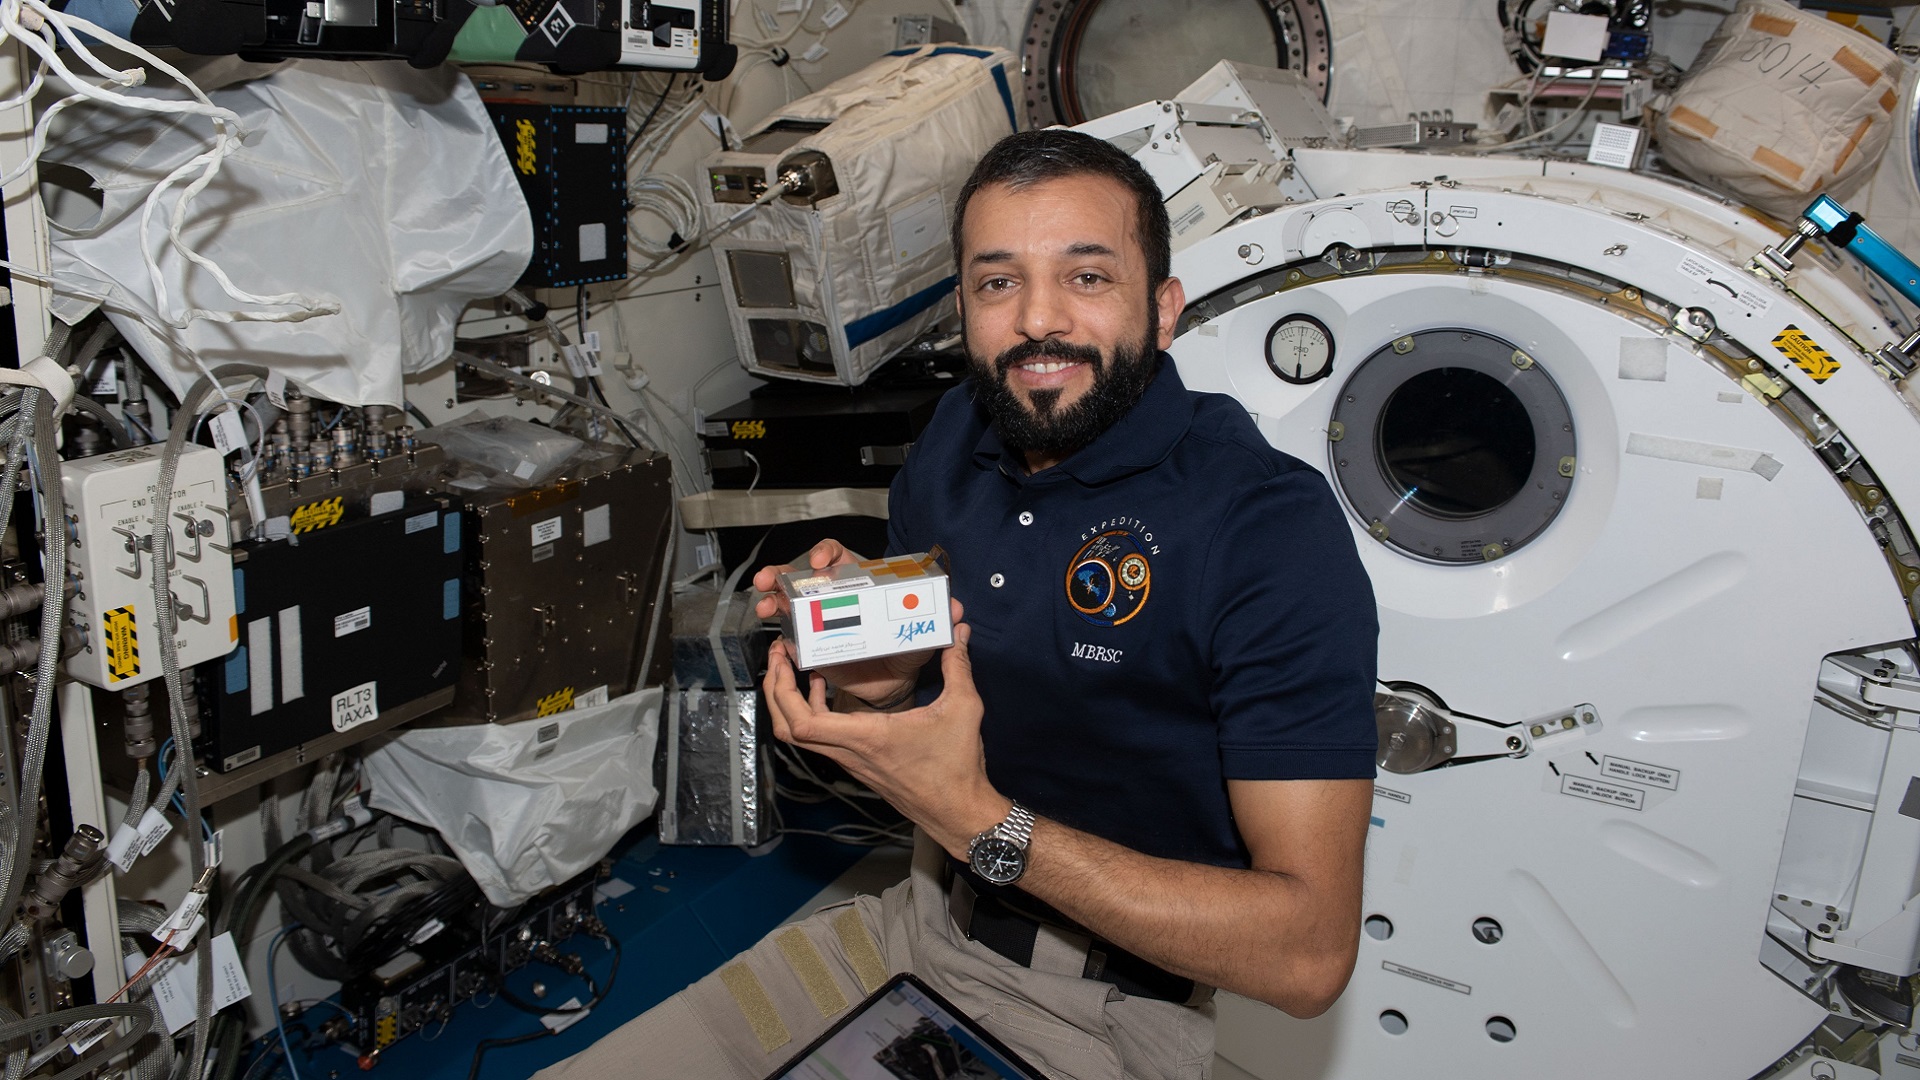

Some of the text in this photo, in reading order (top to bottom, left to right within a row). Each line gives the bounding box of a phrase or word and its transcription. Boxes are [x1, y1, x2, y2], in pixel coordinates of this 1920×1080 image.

[1790, 334, 1812, 354] CAUTION
[132, 490, 186, 508] END ECTOR
[178, 502, 197, 512] ENABLE
[118, 517, 138, 526] ENABLE
[1082, 516, 1160, 556] EXPEDITION
[894, 620, 936, 645] JAXA
[120, 625, 130, 660] WARNING
[1071, 642, 1122, 664] MBRSC
[336, 688, 371, 712] RLT3
[336, 705, 372, 728] JAXA
[1609, 767, 1630, 776] HANDLE
[1648, 776, 1670, 784] BUTTON
[1610, 762, 1631, 771] MANUAL
[1388, 792, 1406, 800] HANDLE
[1569, 786, 1636, 804] HANDLE UNLOCK BUTTON
[1573, 781, 1594, 790] MANUAL
[1596, 786, 1618, 794] BACKUP
